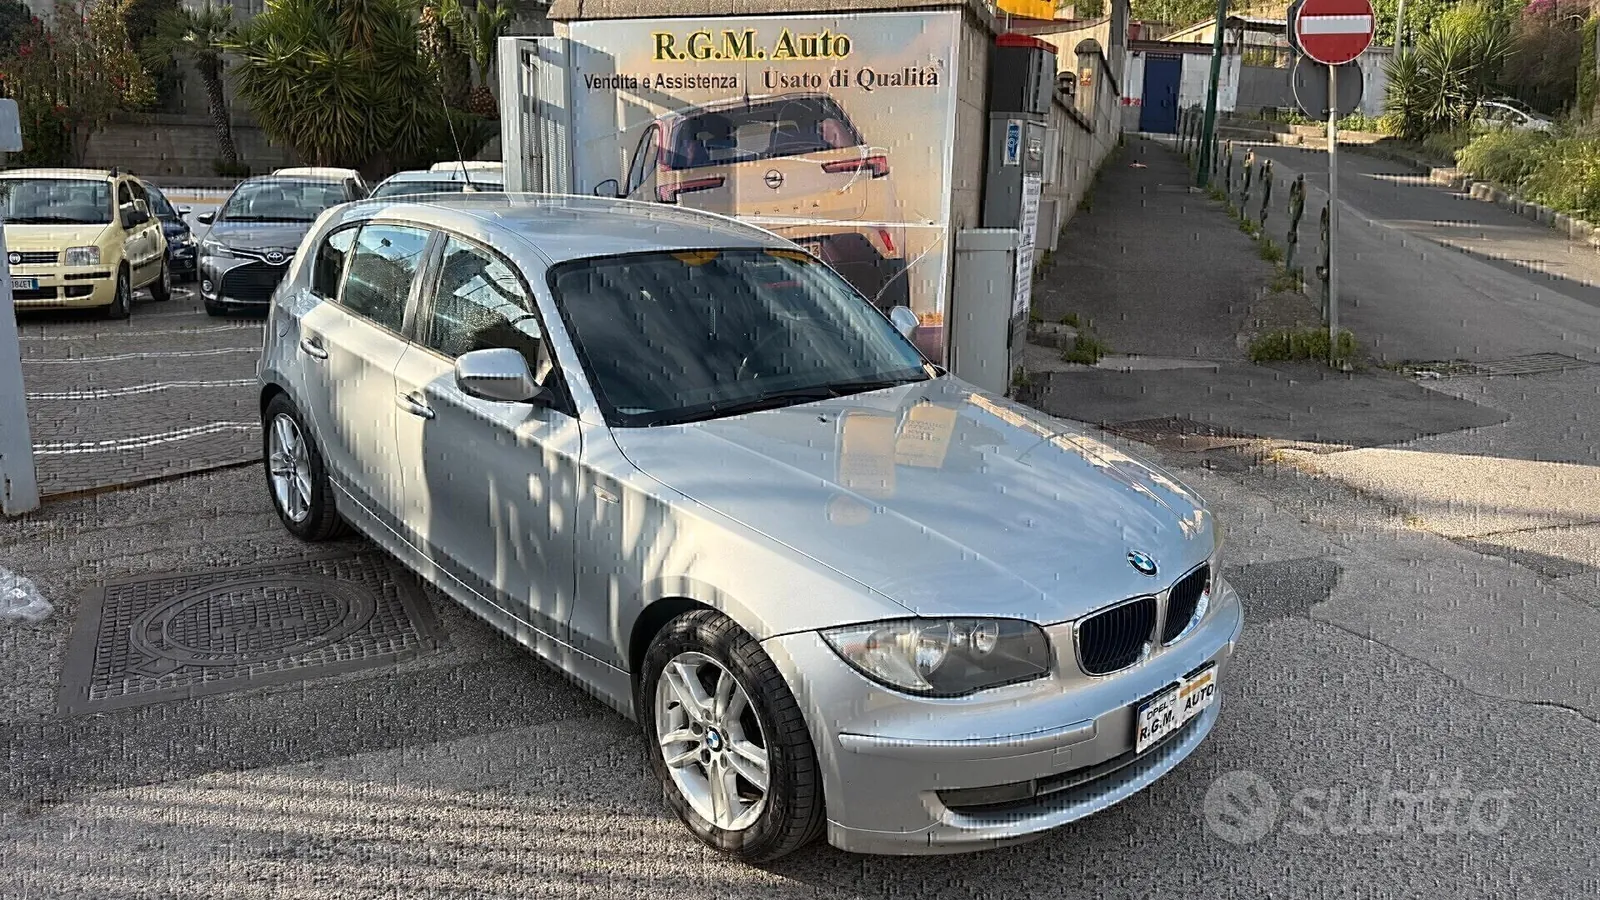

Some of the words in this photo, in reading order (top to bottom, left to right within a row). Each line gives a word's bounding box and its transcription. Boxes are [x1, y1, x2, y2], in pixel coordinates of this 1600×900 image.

[653, 30, 766, 61] R.G.M.
[773, 28, 852, 60] Auto
[584, 73, 638, 89] Vendita
[642, 76, 650, 89] e
[654, 73, 738, 89] Assistenza
[764, 70, 822, 89] Usato
[829, 69, 849, 88] di
[856, 67, 939, 91] Qualità
[1139, 710, 1175, 742] R.G.M.
[1184, 684, 1214, 712] AUTO
[1146, 701, 1168, 720] OPEL
